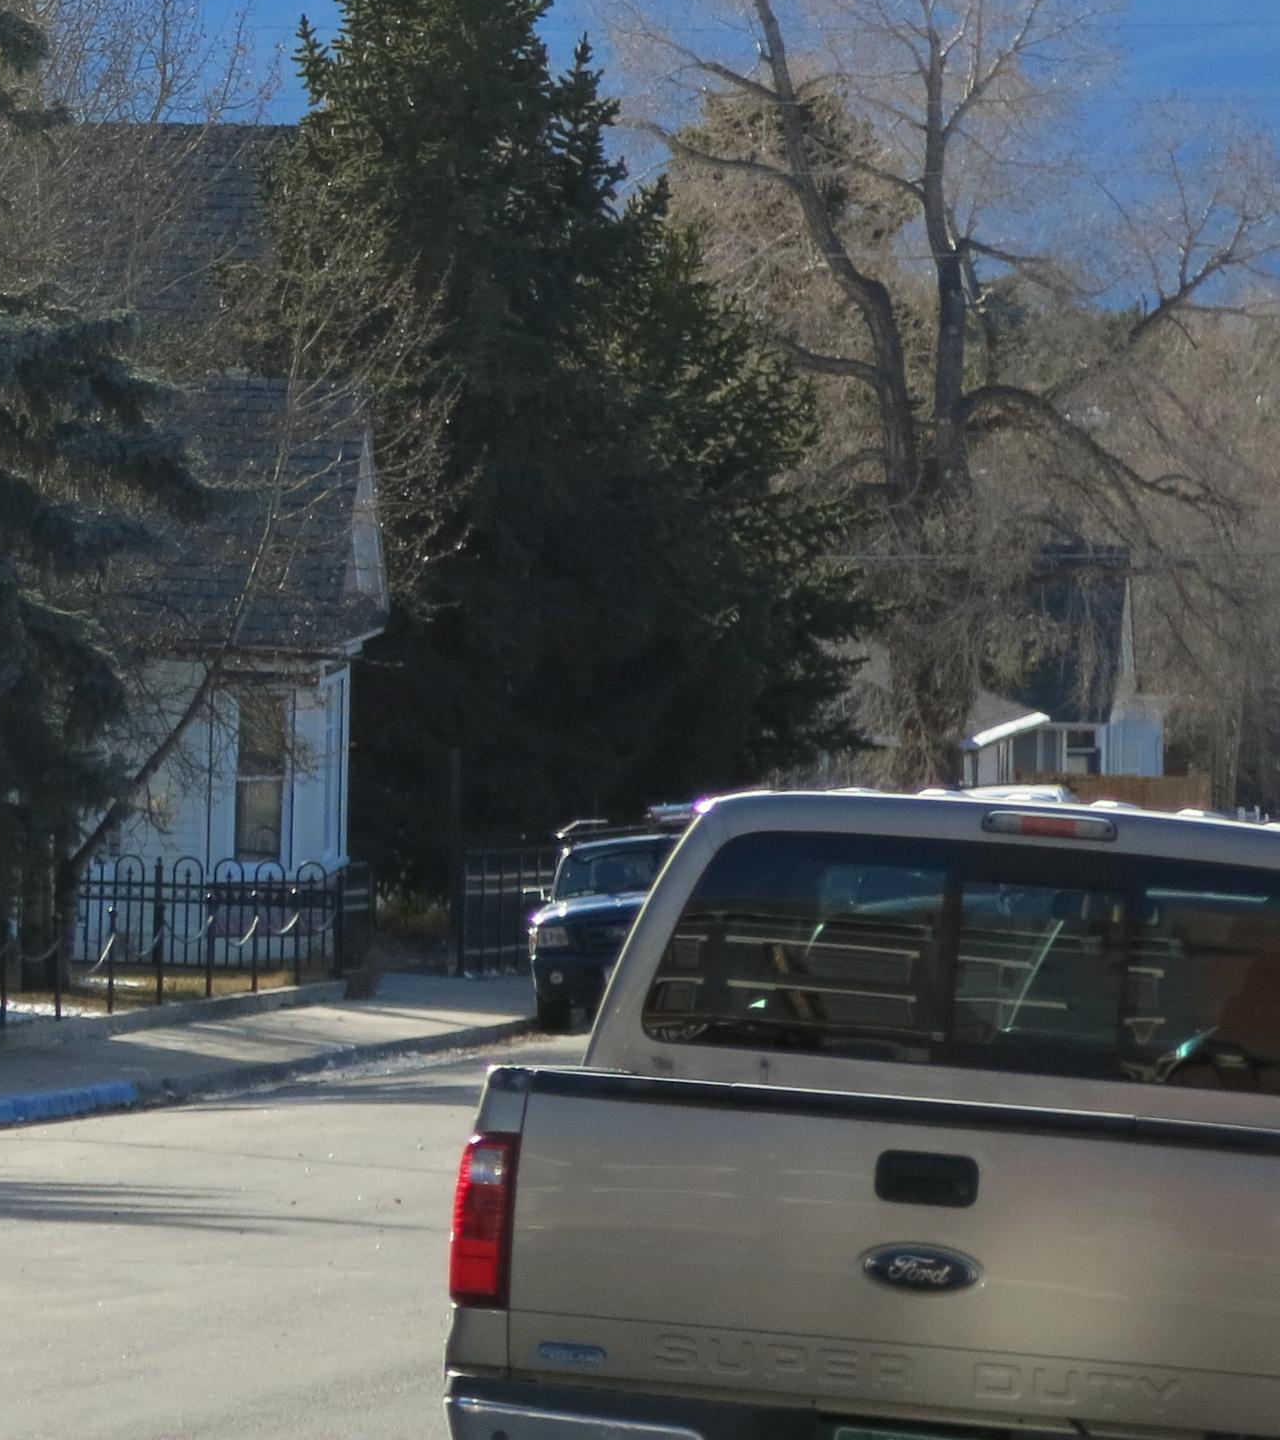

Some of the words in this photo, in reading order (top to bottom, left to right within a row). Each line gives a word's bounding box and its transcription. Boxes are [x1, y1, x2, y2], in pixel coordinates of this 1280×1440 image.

[887, 1254, 952, 1285] Ford
[651, 1333, 916, 1393] SUPER
[974, 1359, 1184, 1416] DUTY
